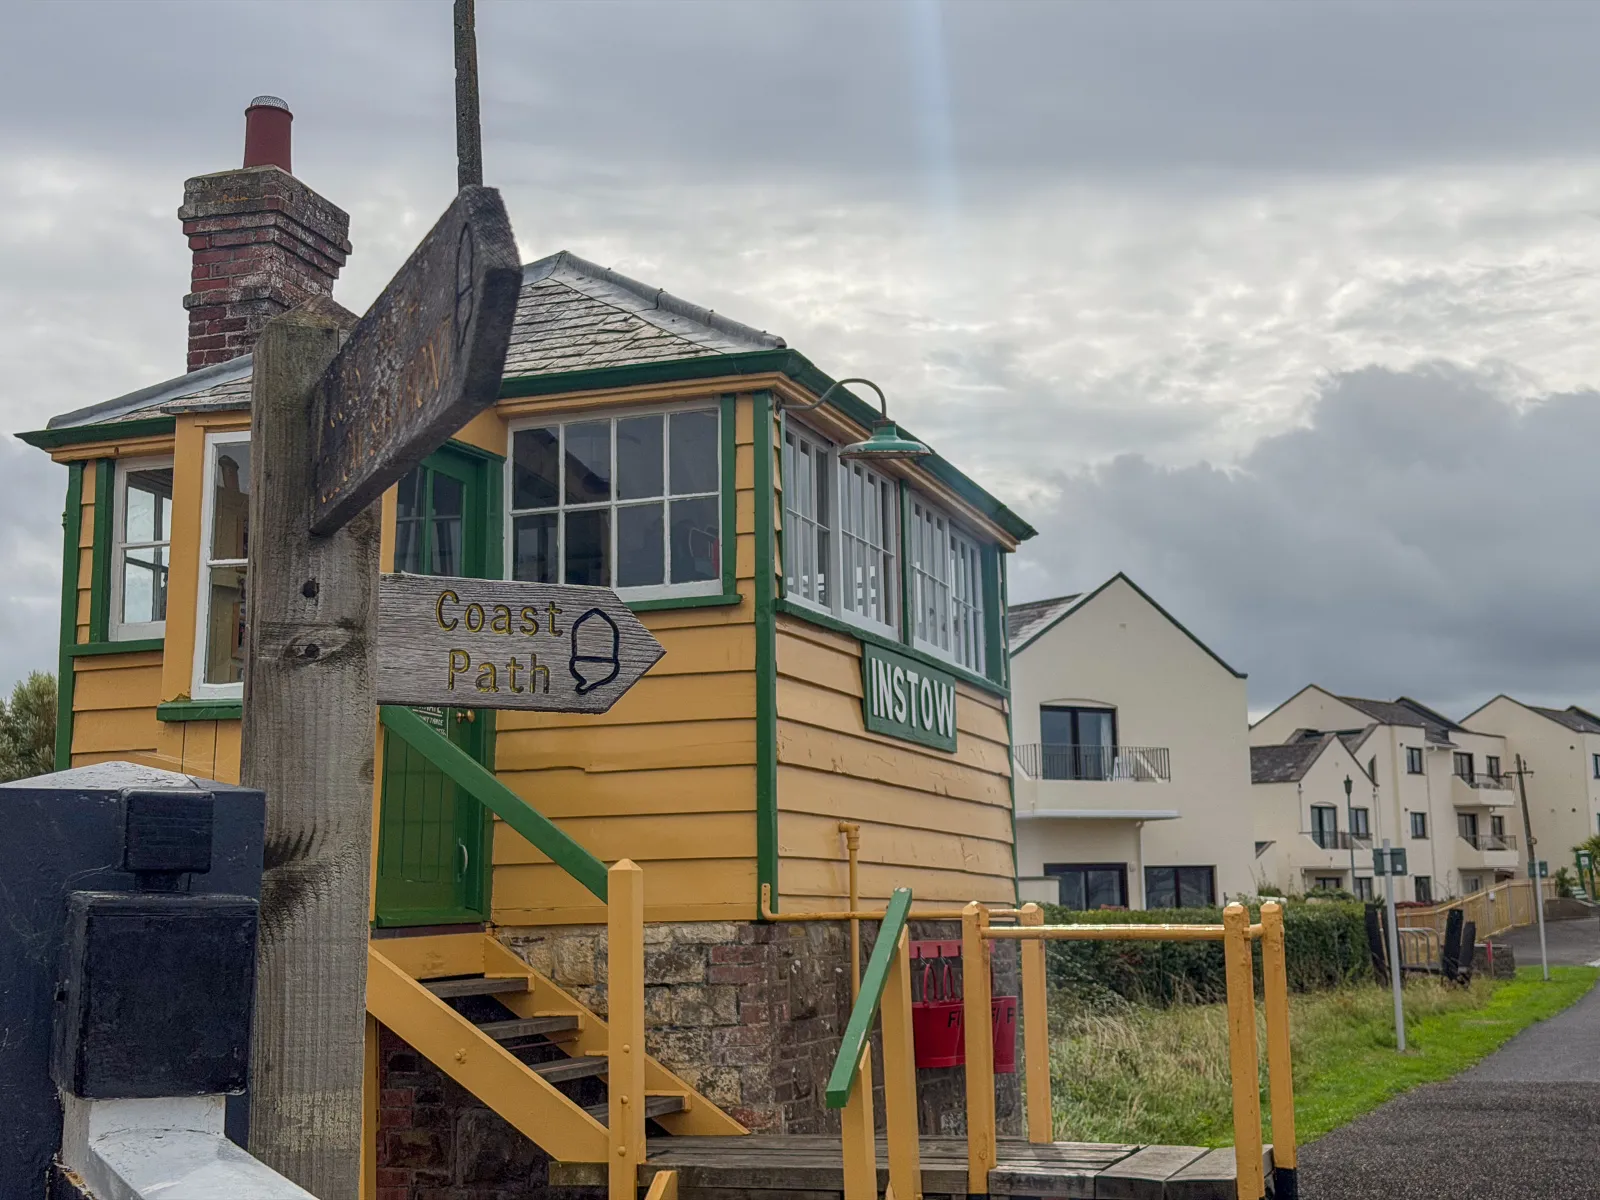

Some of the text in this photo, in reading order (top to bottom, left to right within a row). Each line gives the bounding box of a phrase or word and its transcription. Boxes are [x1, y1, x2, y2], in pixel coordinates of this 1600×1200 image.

[435, 589, 564, 637] Coast
[447, 649, 550, 694] Path
[871, 657, 954, 738] INSTOW
